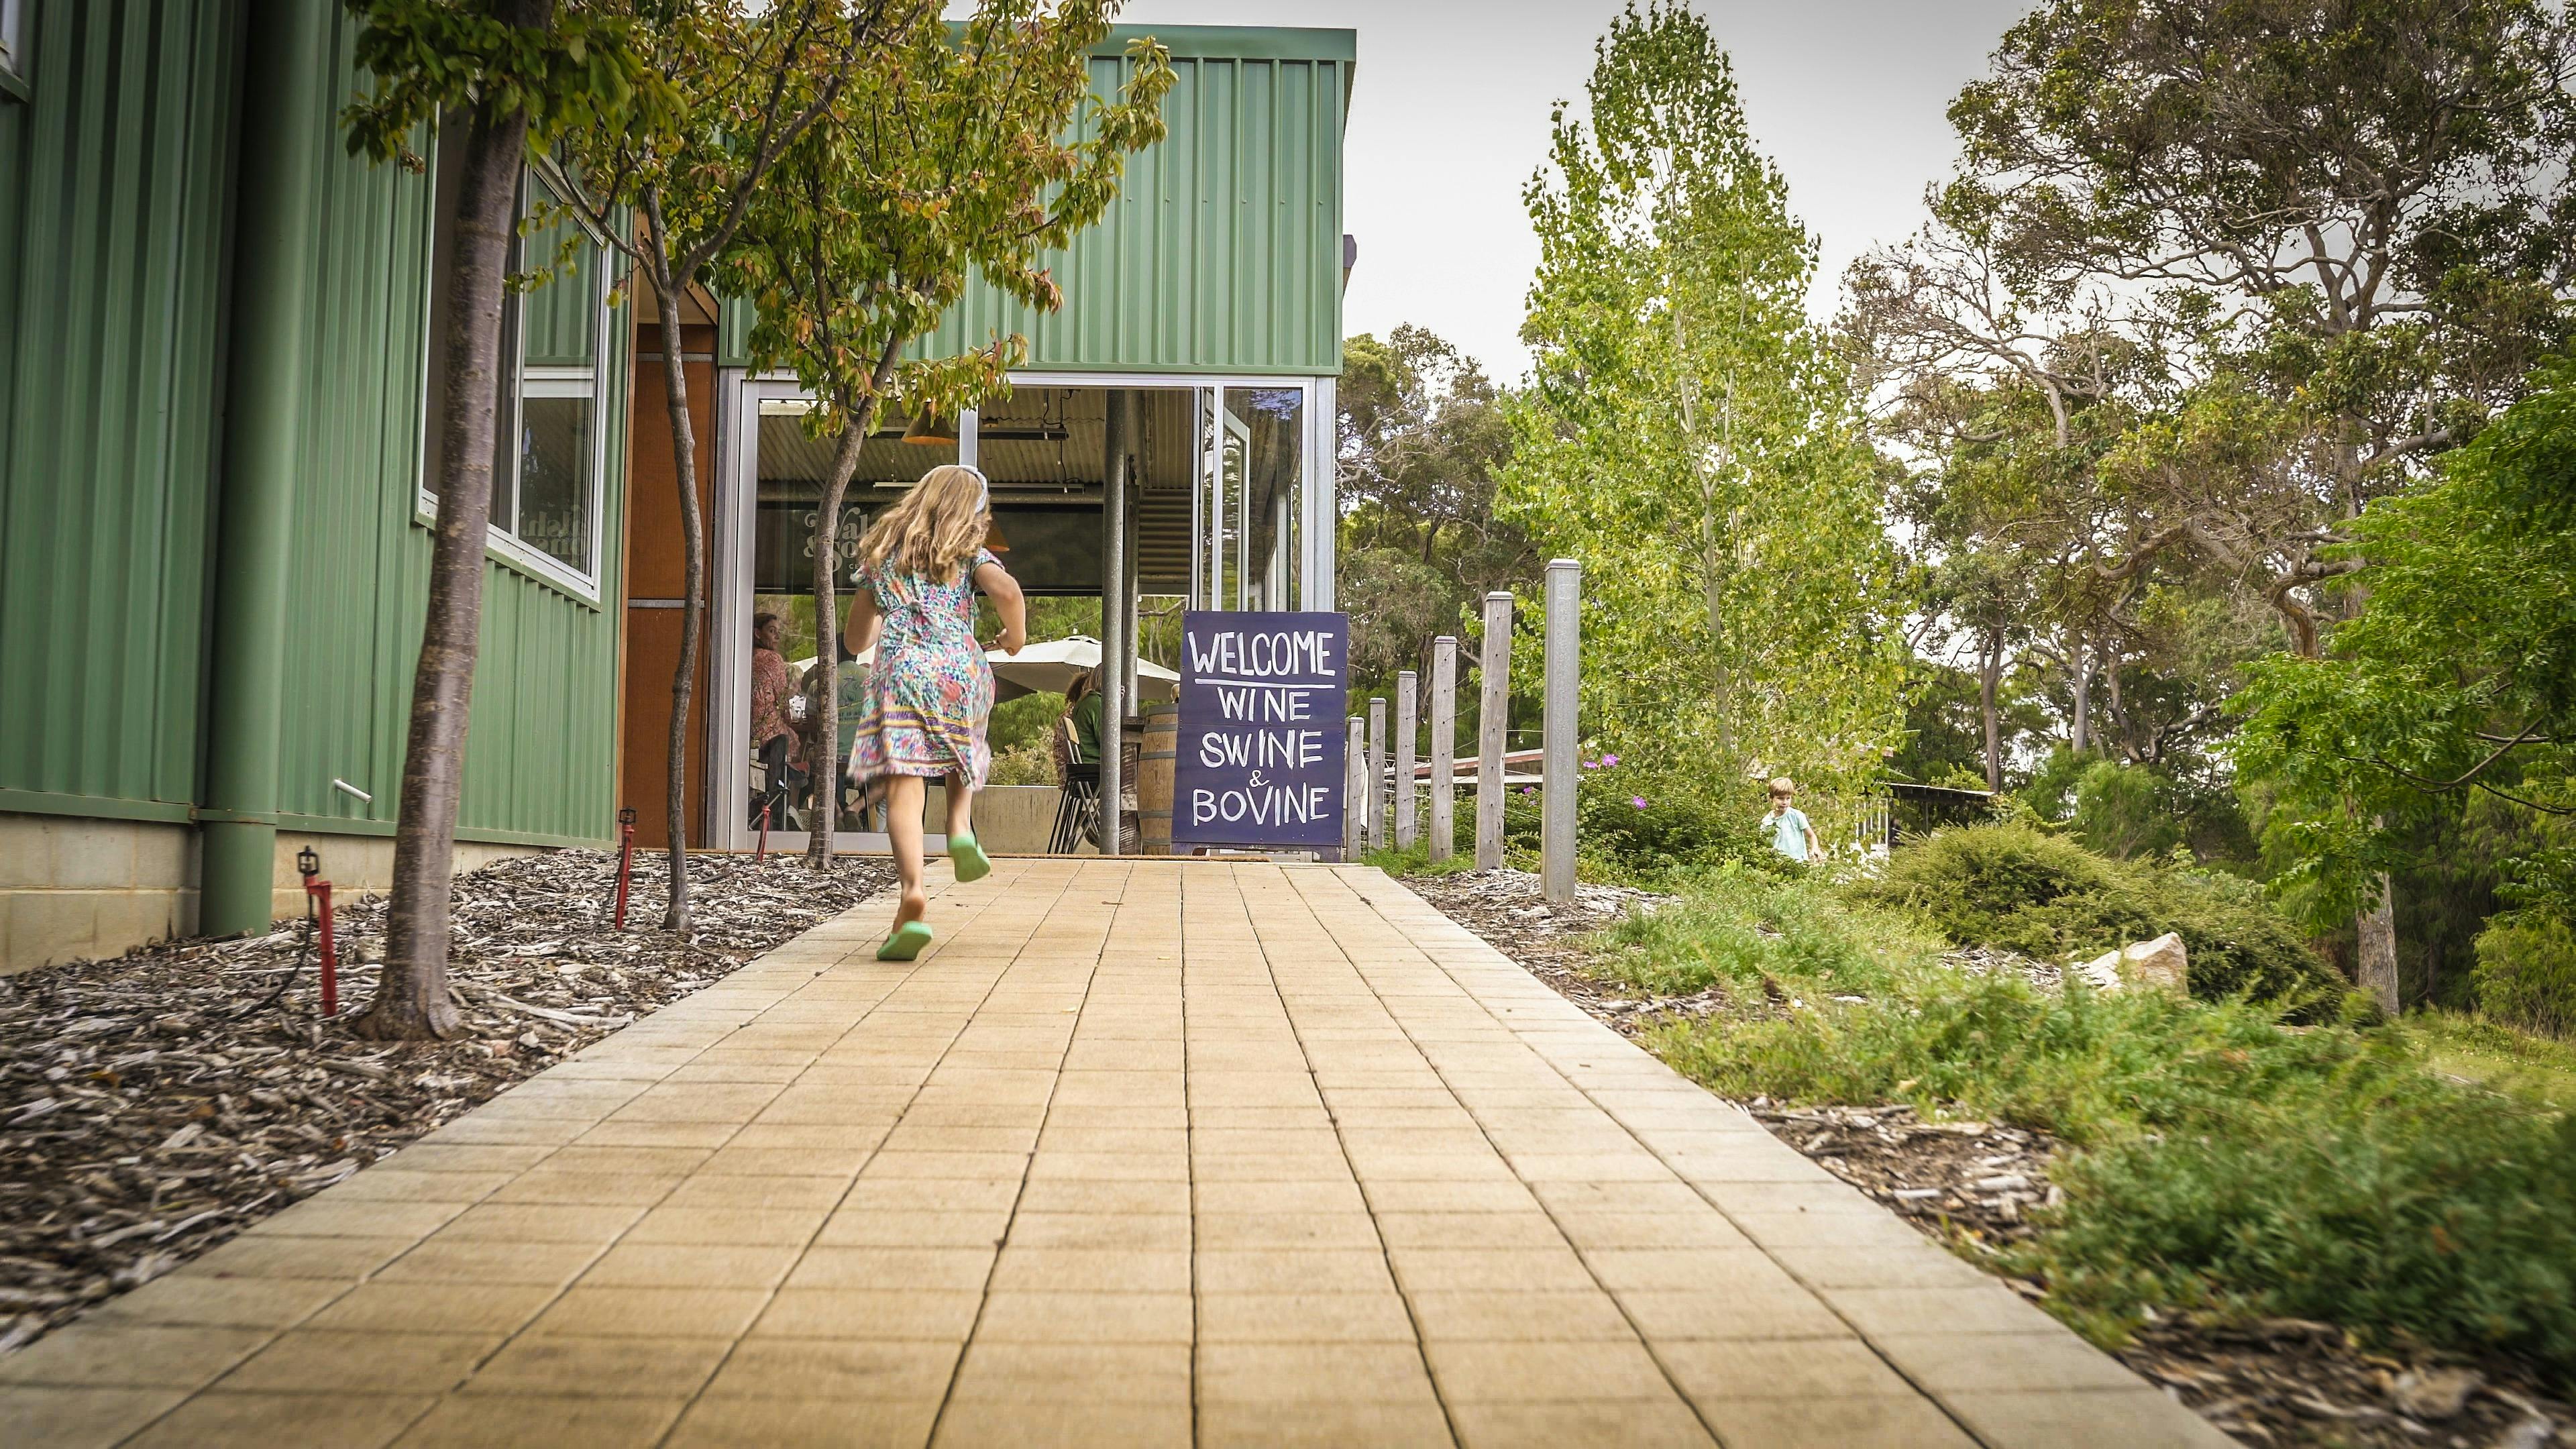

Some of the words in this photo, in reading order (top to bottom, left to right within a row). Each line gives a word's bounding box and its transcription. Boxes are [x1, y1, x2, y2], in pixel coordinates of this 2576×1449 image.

[1187, 631, 1336, 676] WELCOME
[1217, 686, 1311, 722] WINE
[1199, 729, 1324, 769] SWINE
[1249, 769, 1270, 788] &
[1193, 782, 1330, 827] BOVINE
